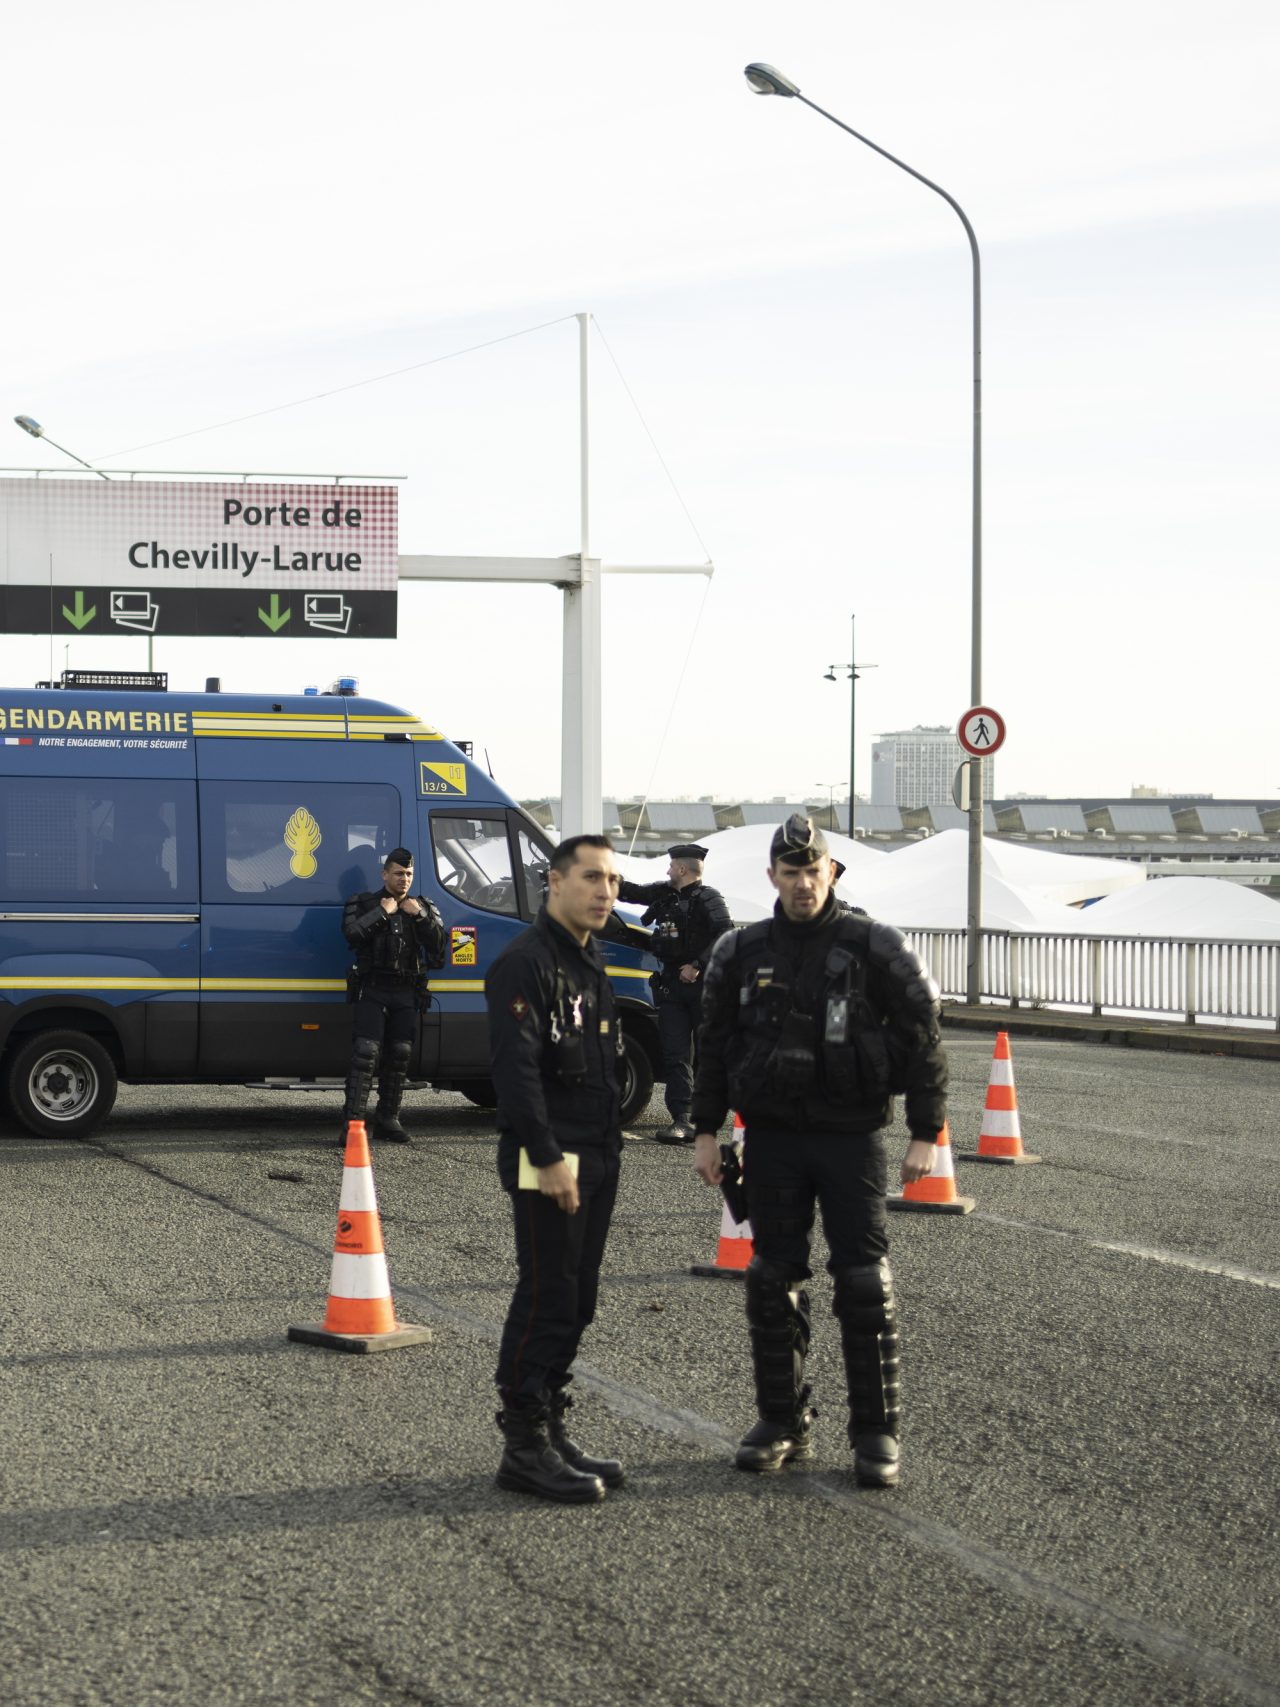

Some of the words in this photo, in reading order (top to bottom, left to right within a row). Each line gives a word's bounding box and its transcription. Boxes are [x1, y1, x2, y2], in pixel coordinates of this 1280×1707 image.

[223, 499, 311, 526] Porte
[321, 500, 362, 527] de
[128, 541, 362, 578] Chevilly-Larue
[38, 737, 64, 747] NOTRE
[66, 738, 121, 749] ENGAGEMENT,
[123, 738, 148, 748] VOTRE
[149, 737, 188, 749] SÉCURITÉ
[424, 782, 448, 792] 13/9
